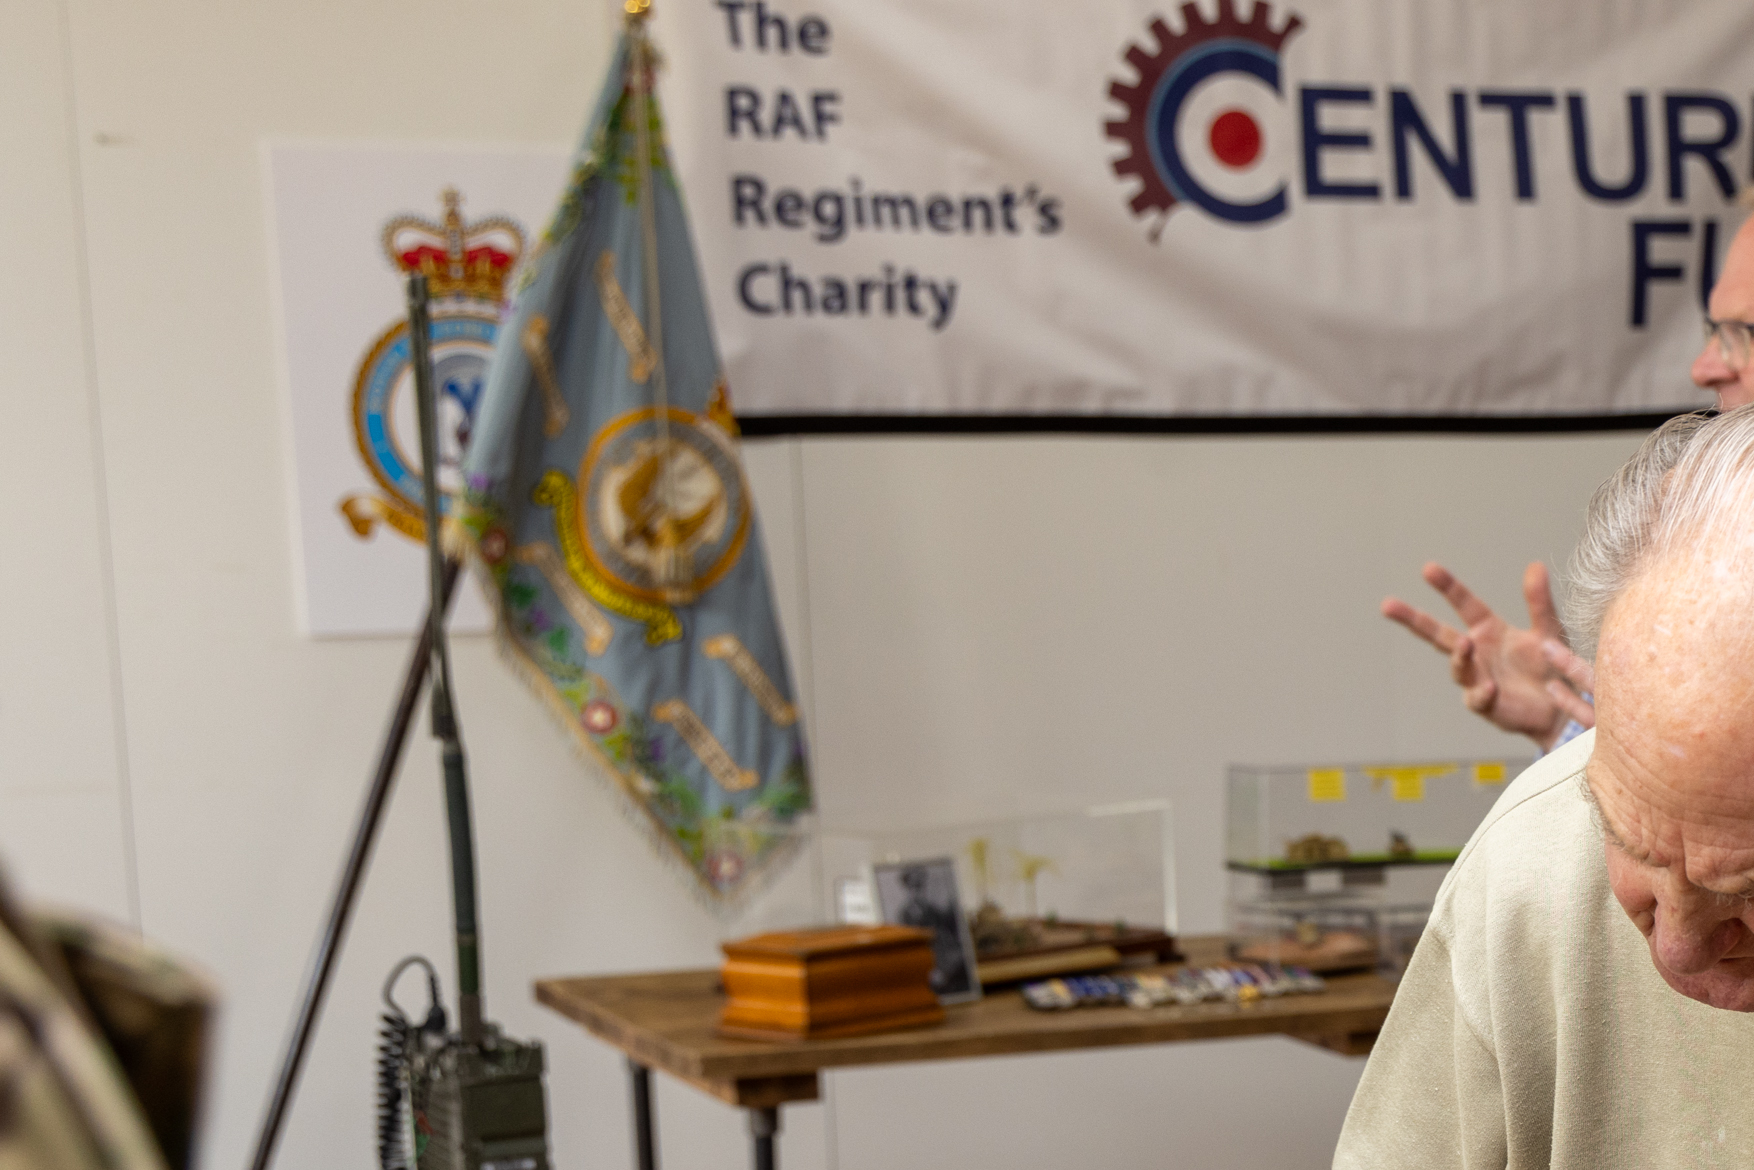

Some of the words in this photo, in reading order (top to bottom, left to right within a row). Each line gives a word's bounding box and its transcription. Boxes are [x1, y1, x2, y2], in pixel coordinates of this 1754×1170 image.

[719, 0, 829, 55] The
[726, 87, 842, 141] RAF
[737, 263, 958, 331] Charity
